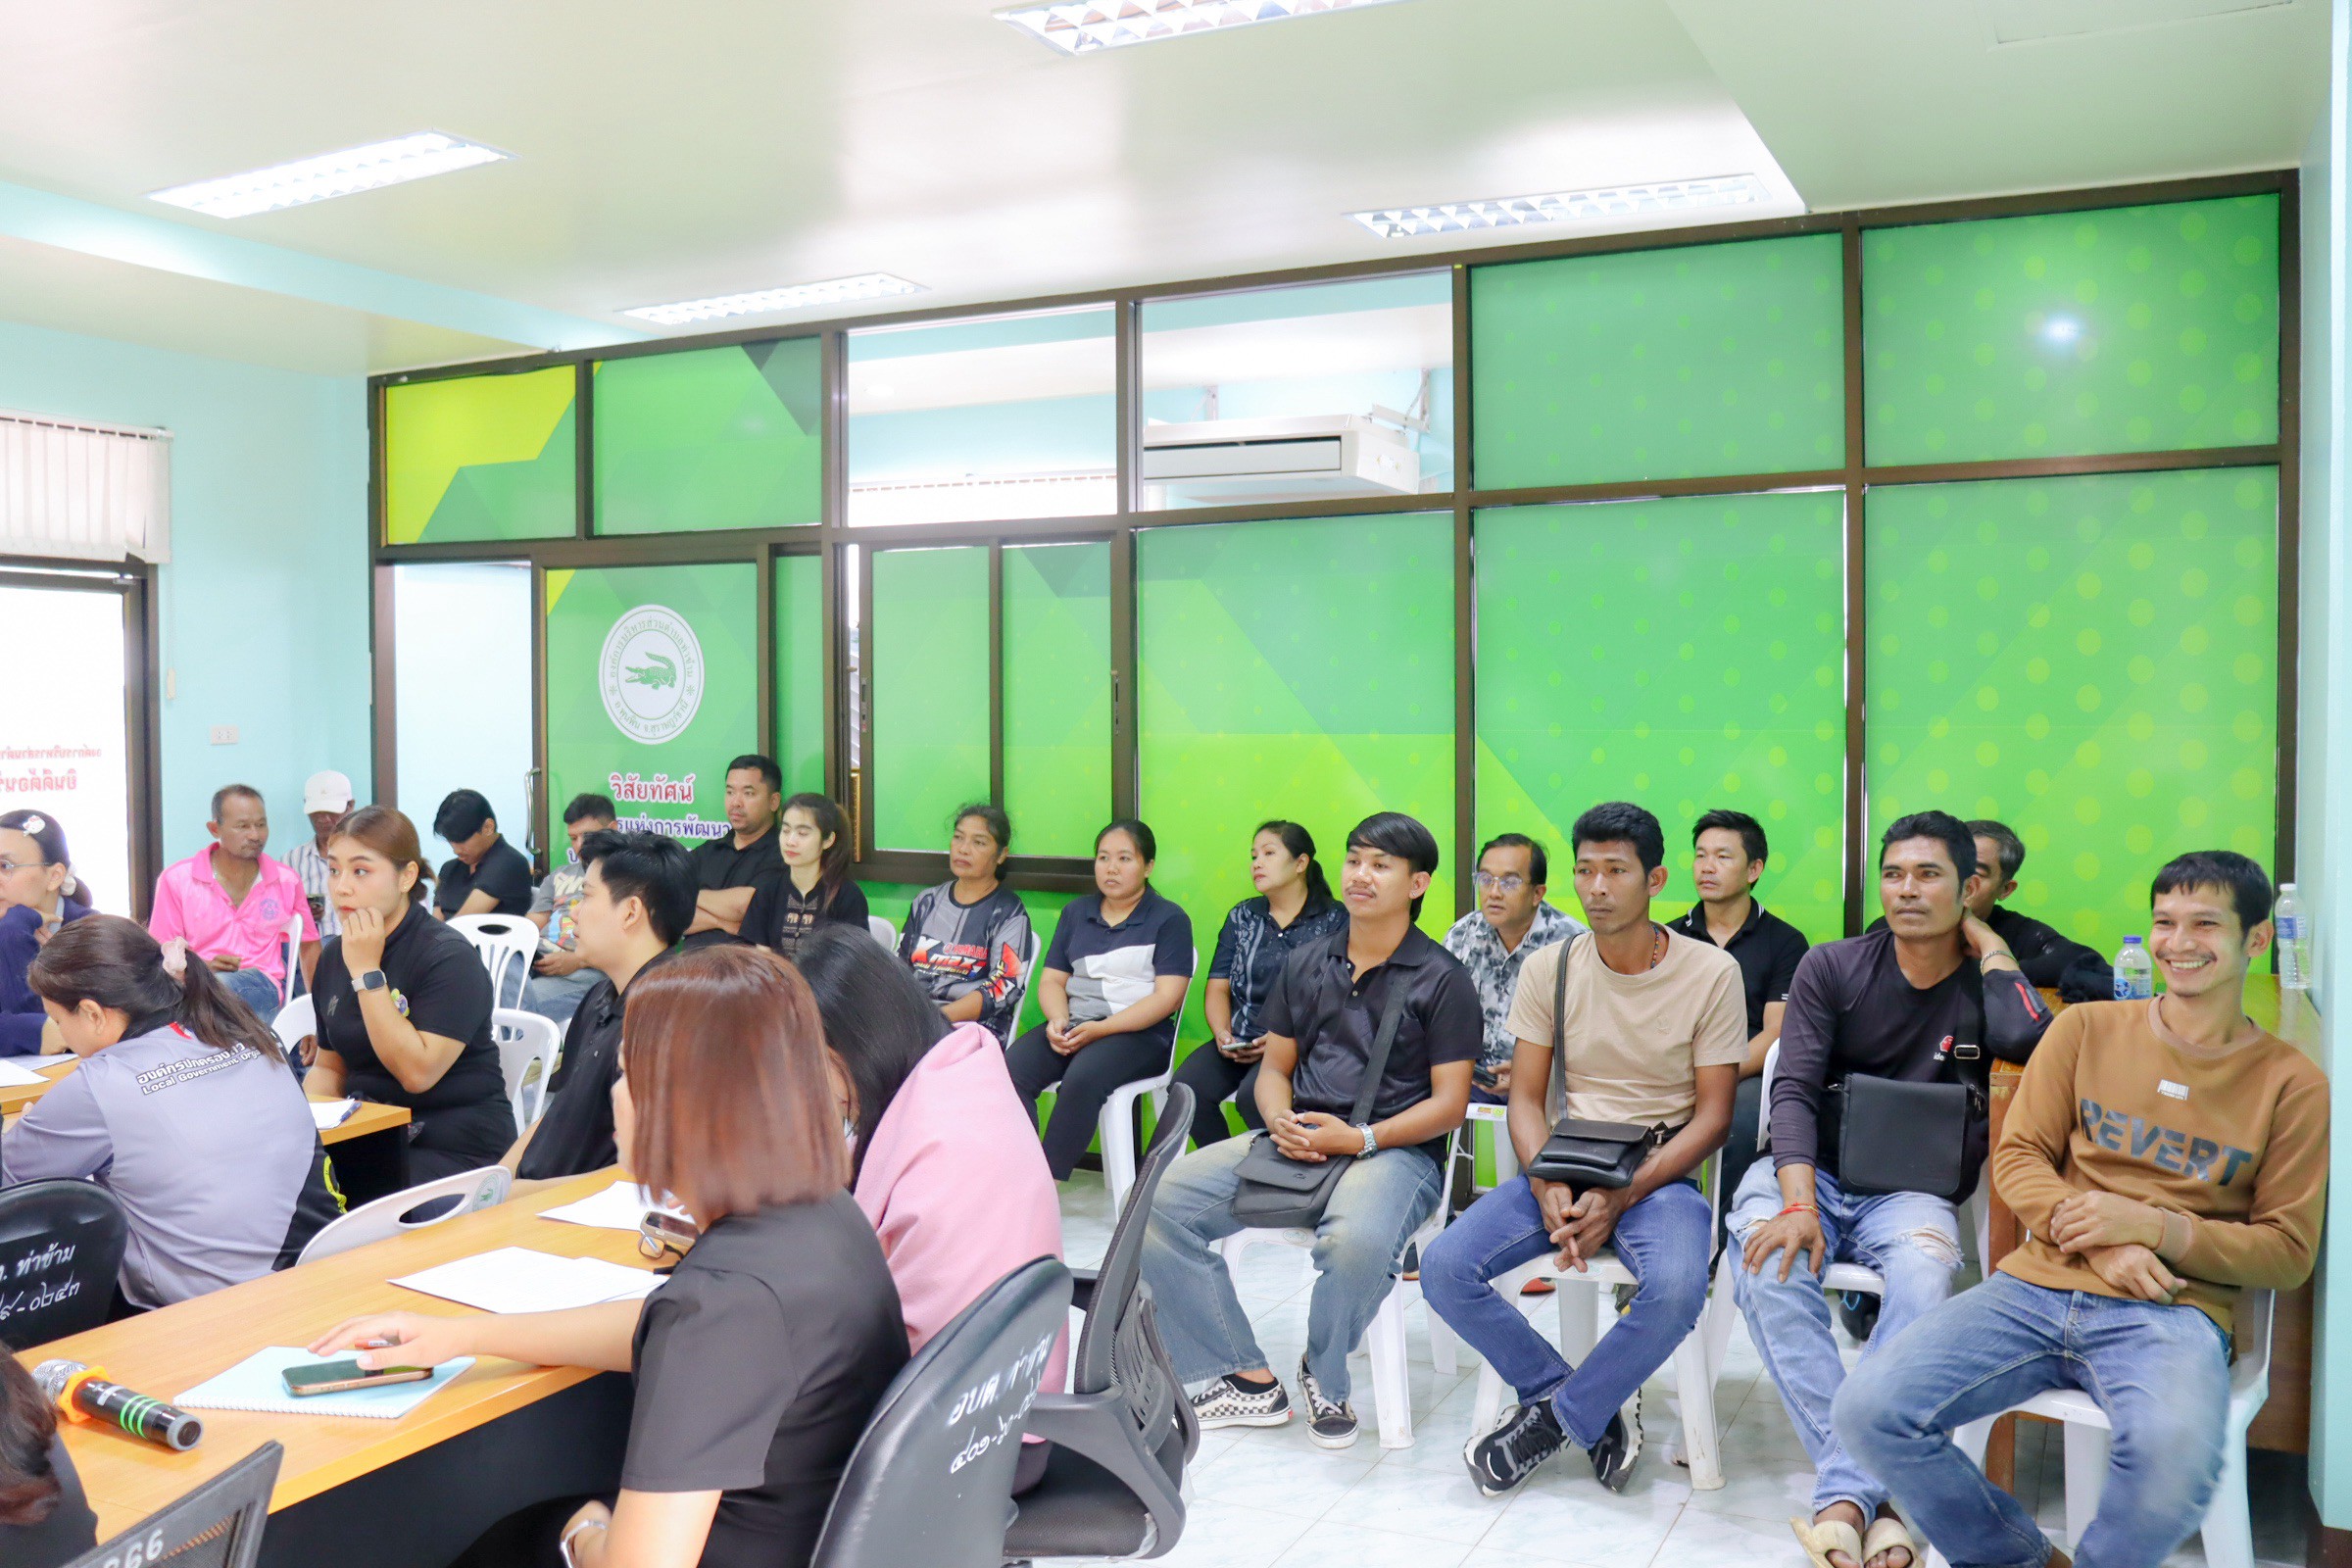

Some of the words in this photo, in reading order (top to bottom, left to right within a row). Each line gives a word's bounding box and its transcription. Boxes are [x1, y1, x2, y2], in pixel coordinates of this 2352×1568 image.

[610, 773, 695, 803] วิสัยทัศน์
[141, 1075, 176, 1096] Local
[177, 1056, 239, 1083] Government
[2080, 1098, 2252, 1187] REVERT
[17, 1242, 76, 1278] ท่าข้าม
